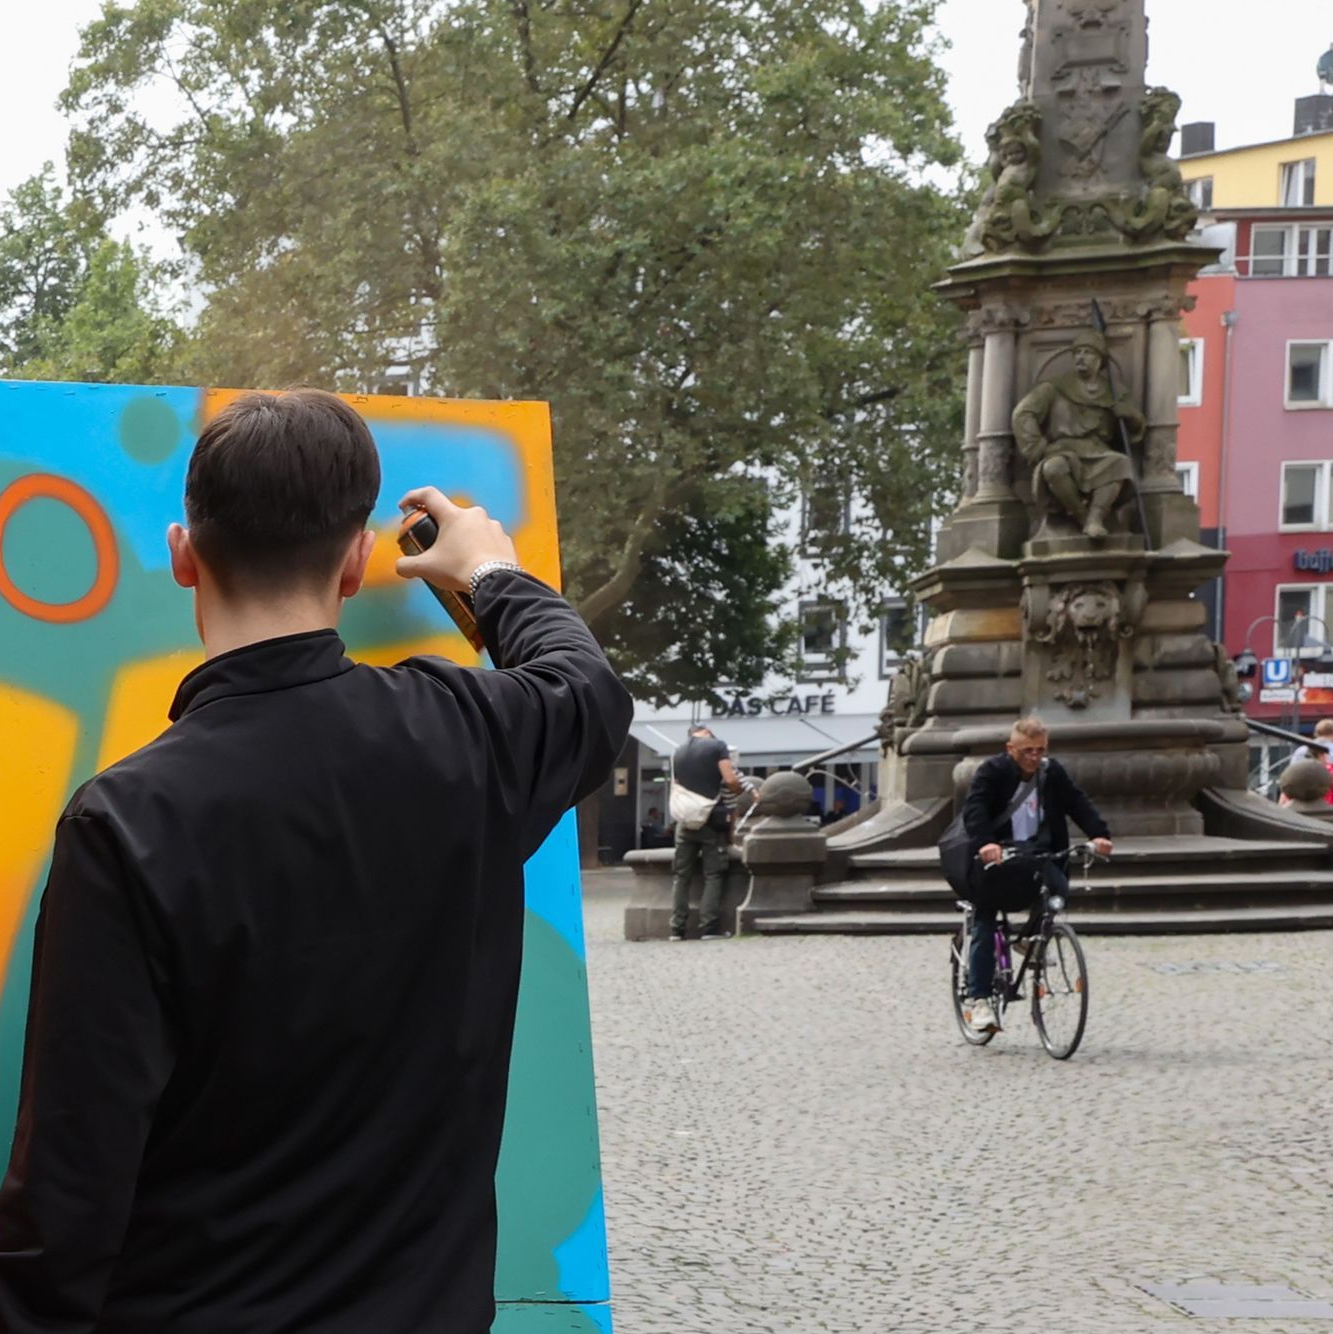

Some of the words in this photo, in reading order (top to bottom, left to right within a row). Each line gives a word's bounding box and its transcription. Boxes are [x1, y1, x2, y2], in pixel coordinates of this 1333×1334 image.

[1267, 660, 1288, 681] U
[711, 693, 763, 717] DAS
[770, 689, 836, 716] CAFÉ
